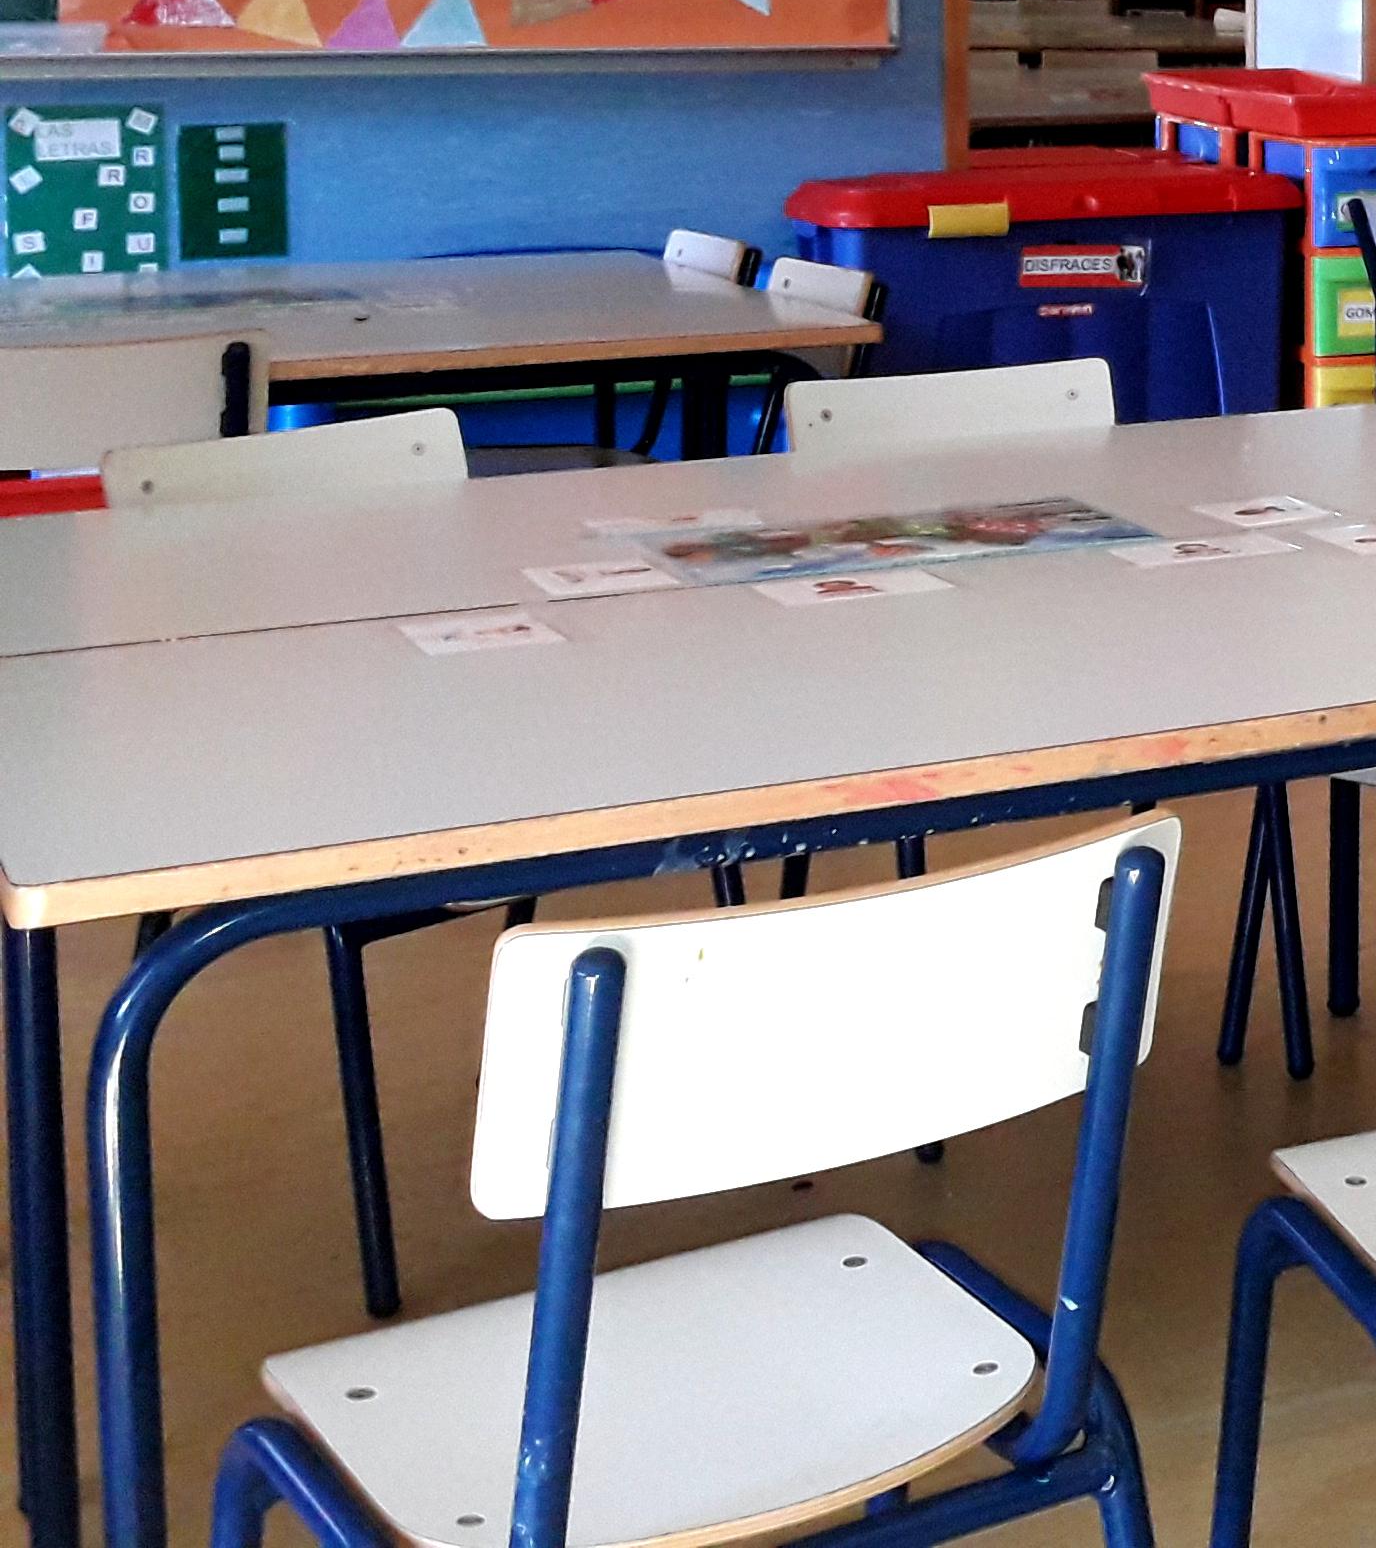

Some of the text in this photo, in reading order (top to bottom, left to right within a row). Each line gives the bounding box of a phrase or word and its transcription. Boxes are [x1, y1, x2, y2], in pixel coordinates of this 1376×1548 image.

[136, 148, 148, 162] R
[107, 168, 121, 182] R
[133, 195, 148, 210] O
[81, 211, 94, 226] F
[22, 235, 36, 250] S
[137, 237, 150, 251] U
[1024, 257, 1114, 273] DISFRACES
